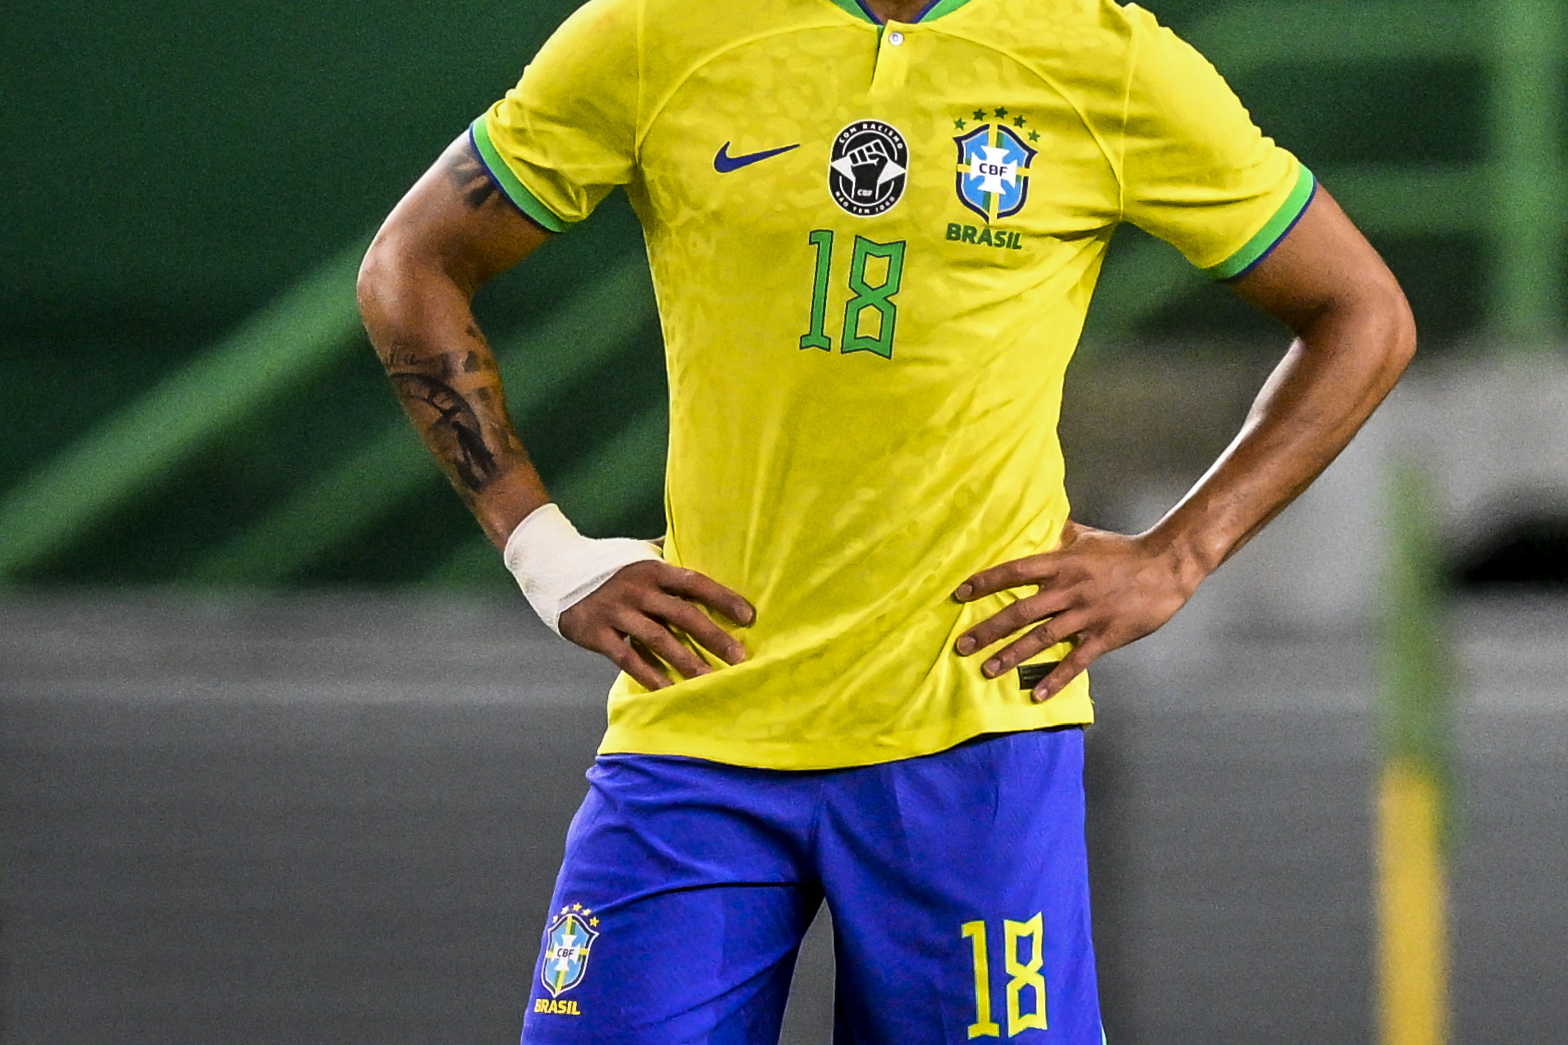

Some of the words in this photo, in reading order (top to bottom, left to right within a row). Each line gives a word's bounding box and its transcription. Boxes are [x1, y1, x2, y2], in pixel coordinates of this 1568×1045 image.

[838, 127, 857, 144] COM
[862, 123, 903, 149] RACISMO
[979, 162, 1008, 177] CBF
[946, 222, 1022, 250] BRASIL
[799, 229, 907, 360] 18
[557, 947, 575, 958] CBF
[960, 911, 1048, 1041] 18
[534, 998, 581, 1016] BRASIL
